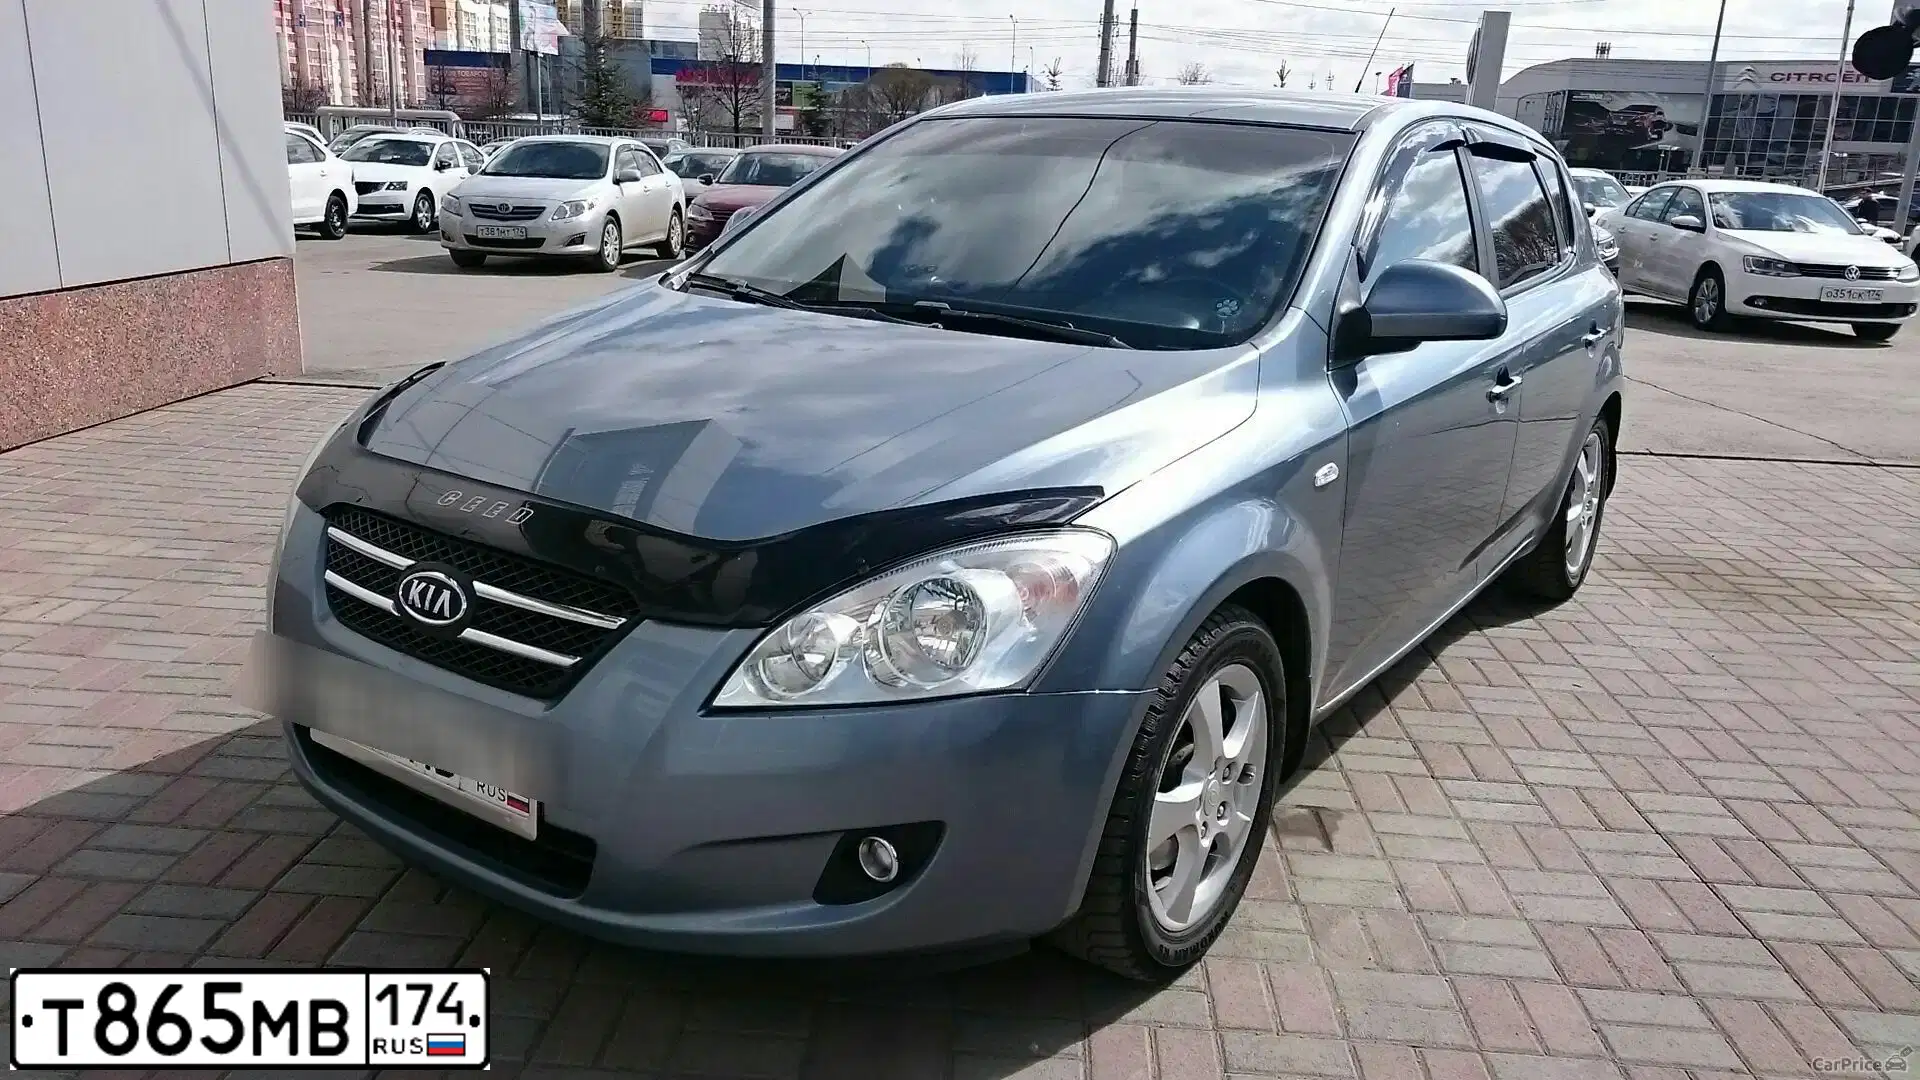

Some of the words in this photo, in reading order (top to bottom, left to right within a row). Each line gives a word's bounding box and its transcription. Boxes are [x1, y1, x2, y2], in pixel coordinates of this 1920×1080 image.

[437, 490, 534, 525] CEED
[407, 579, 451, 618] KIA
[476, 781, 506, 802] RUS
